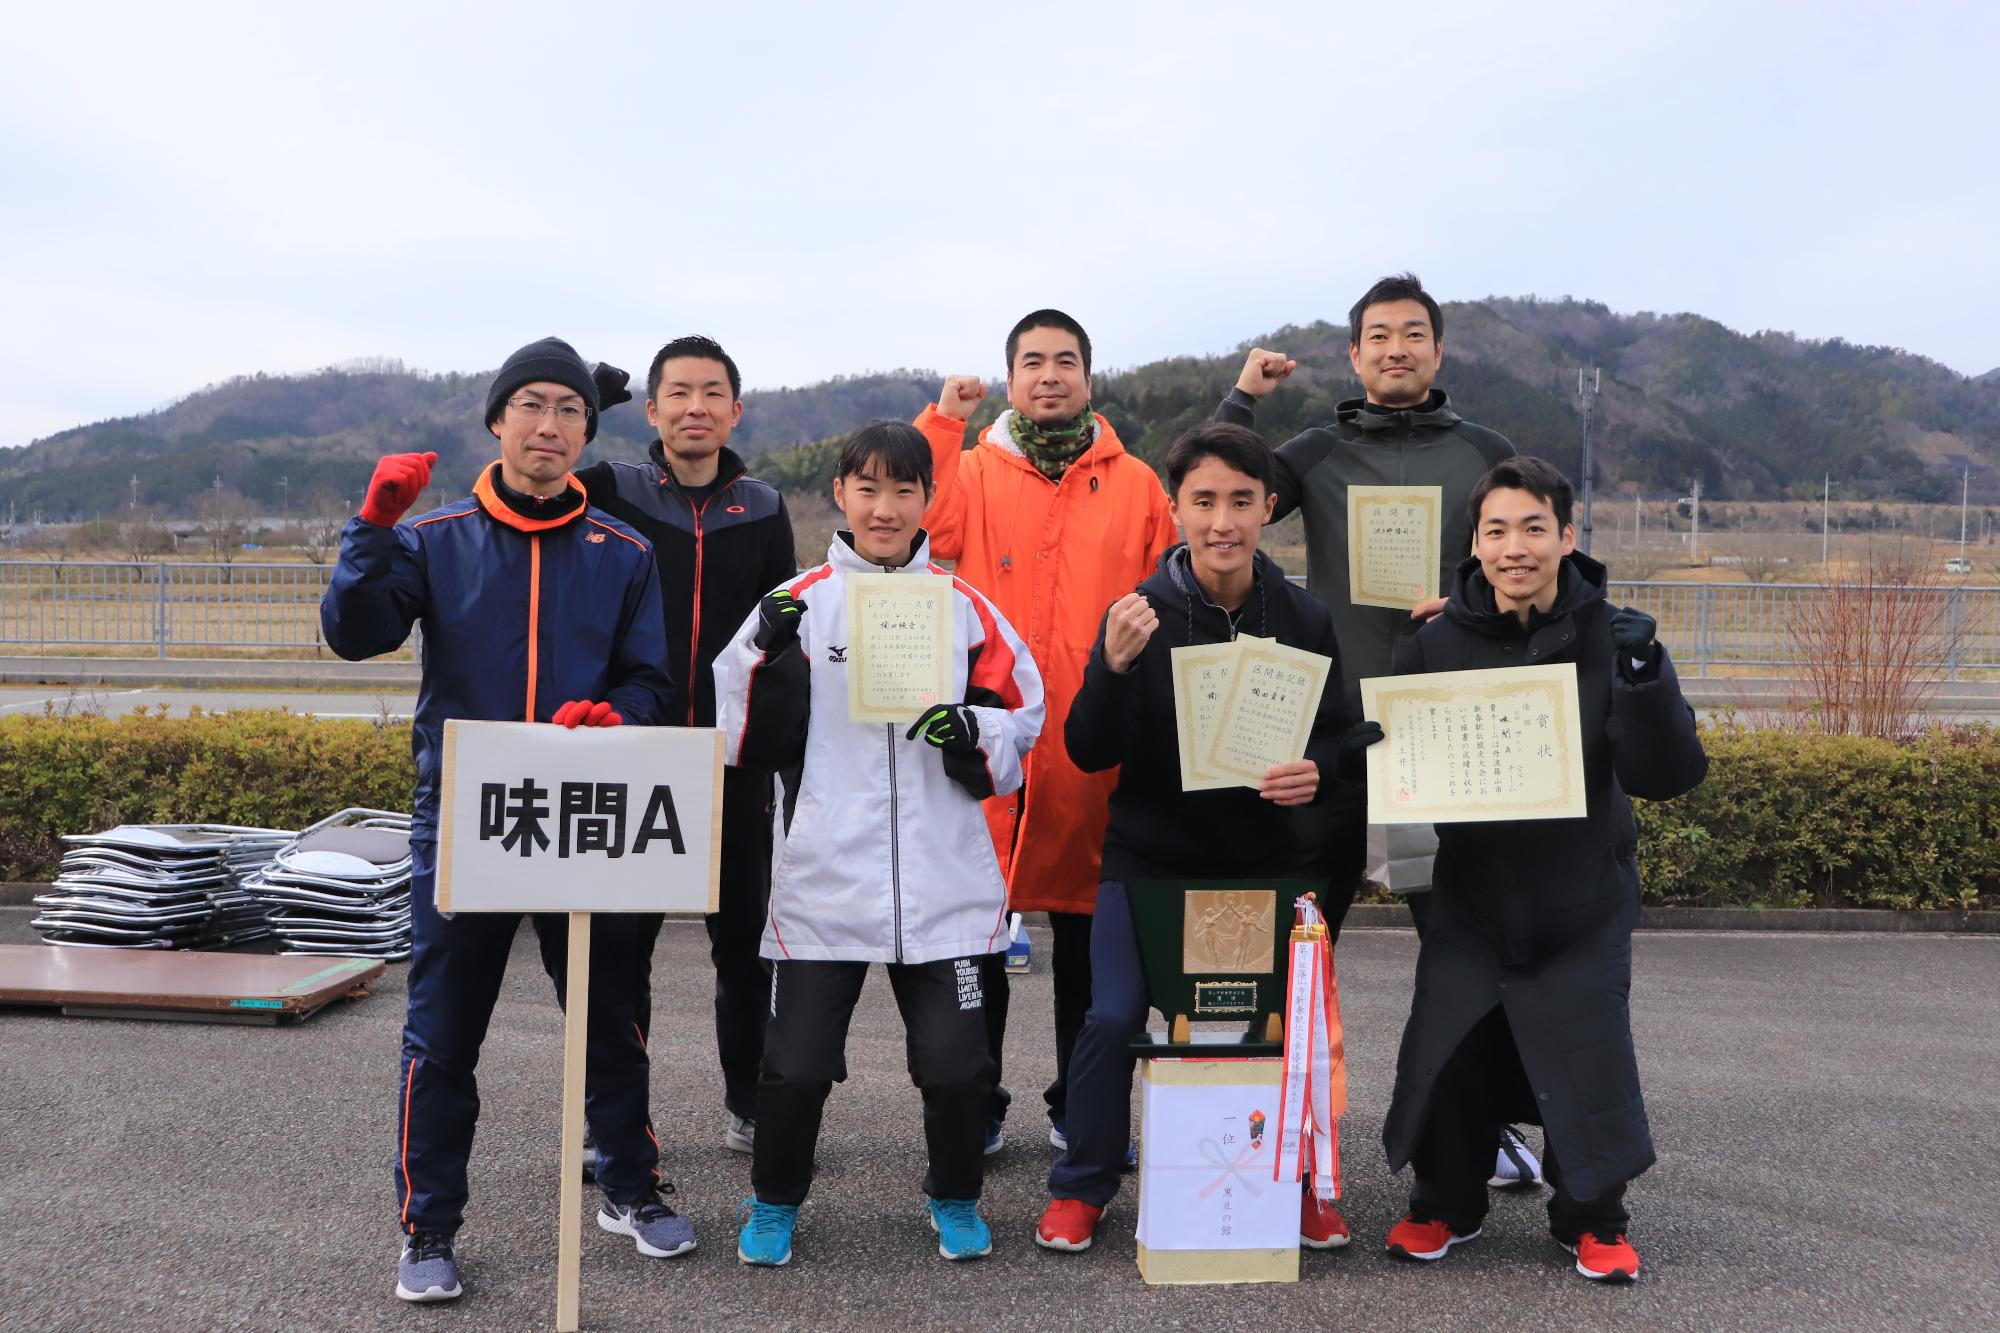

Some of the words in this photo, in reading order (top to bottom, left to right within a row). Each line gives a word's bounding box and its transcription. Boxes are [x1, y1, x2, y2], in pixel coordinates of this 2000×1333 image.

[1536, 713, 1553, 758] 賞状
[479, 778, 687, 859] 味間A
[954, 958, 971, 969] PUSH
[956, 976, 965, 985] TO
[965, 974, 978, 984] YOUR
[958, 992, 972, 1002] LIVE
[959, 999, 982, 1010] MOMENT
[1222, 1116, 1237, 1145] 一位
[1221, 1187, 1234, 1237] 黒豆の館
